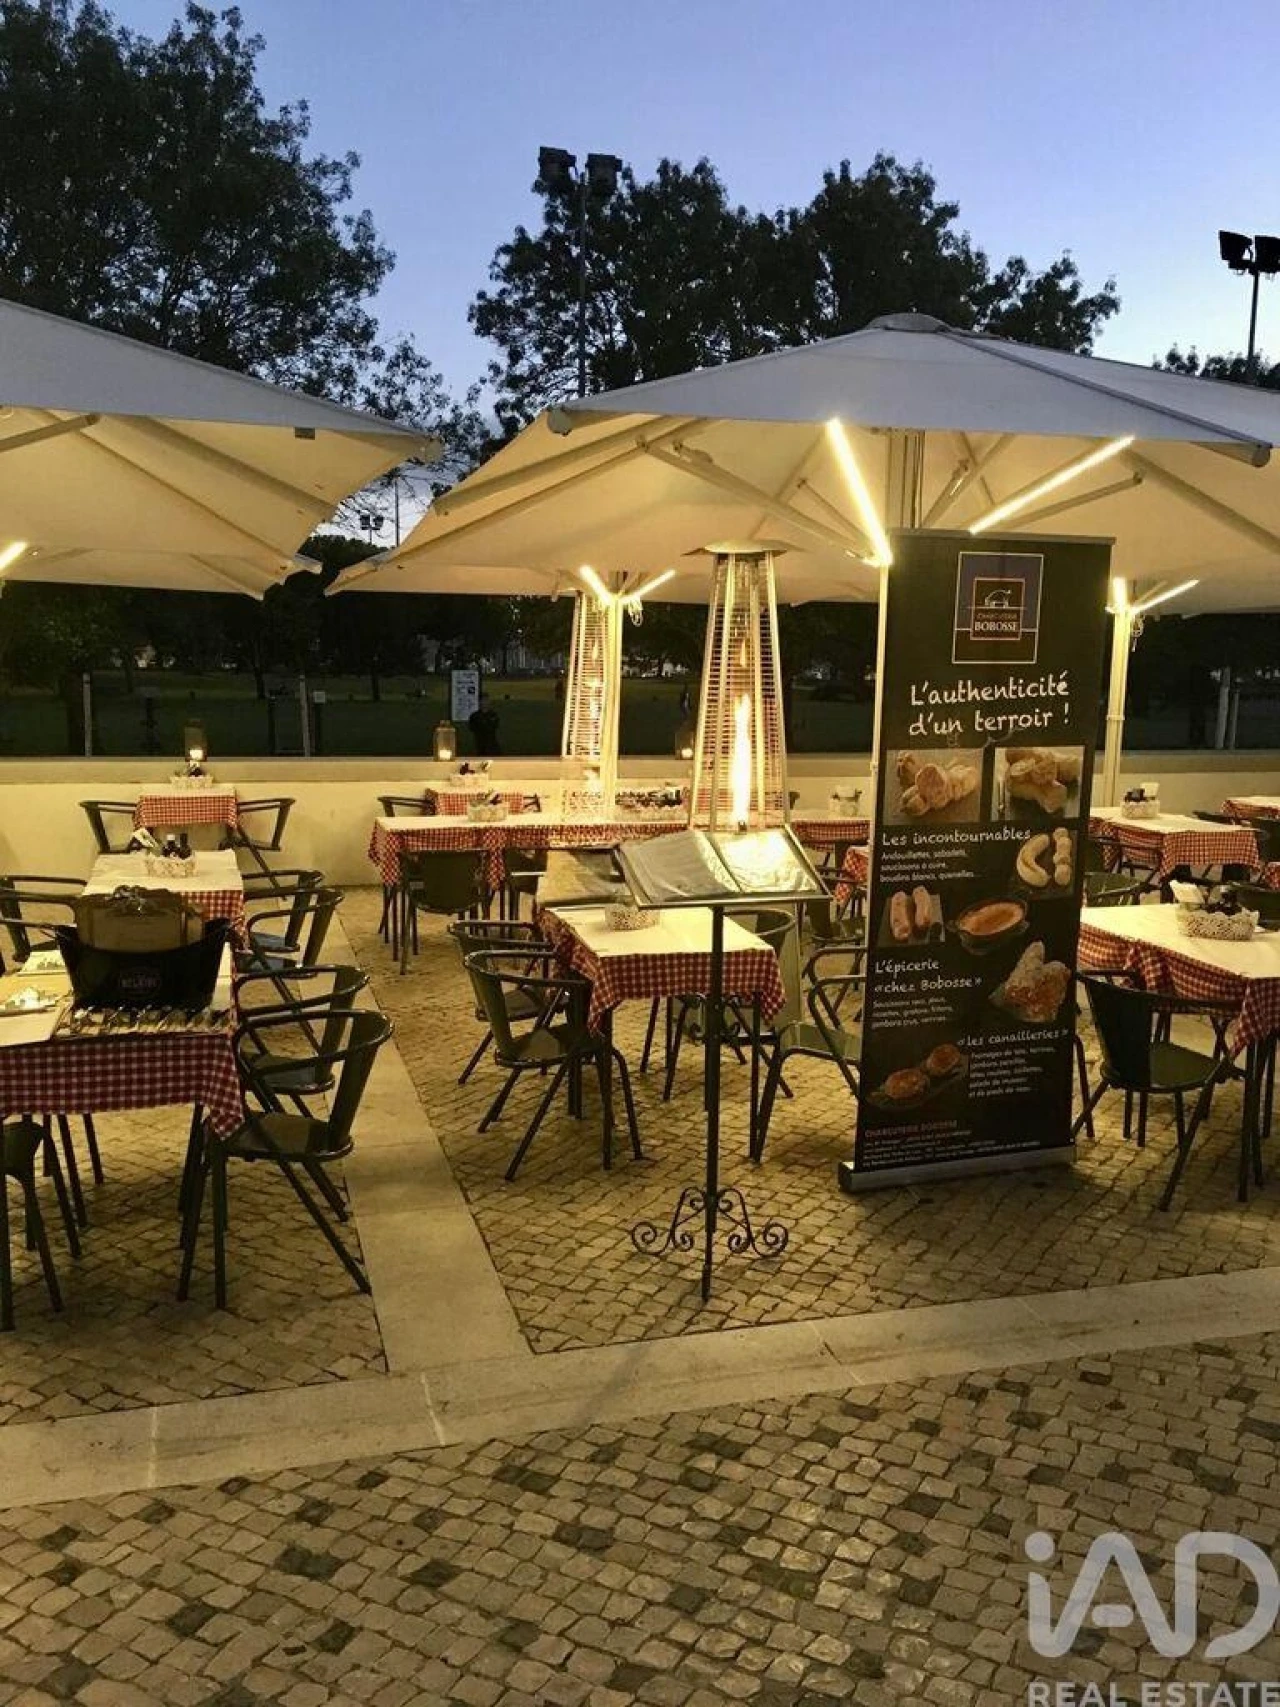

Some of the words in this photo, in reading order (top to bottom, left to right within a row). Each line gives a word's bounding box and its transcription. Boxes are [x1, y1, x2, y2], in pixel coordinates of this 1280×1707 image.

[974, 621, 1017, 631] BOBOSSE
[910, 670, 1069, 706] L'authenticité
[909, 713, 963, 736] d'un
[974, 709, 1053, 731] terroir
[882, 833, 907, 846] Les
[912, 825, 1031, 845] incontournables
[875, 959, 940, 979] L'épicerie
